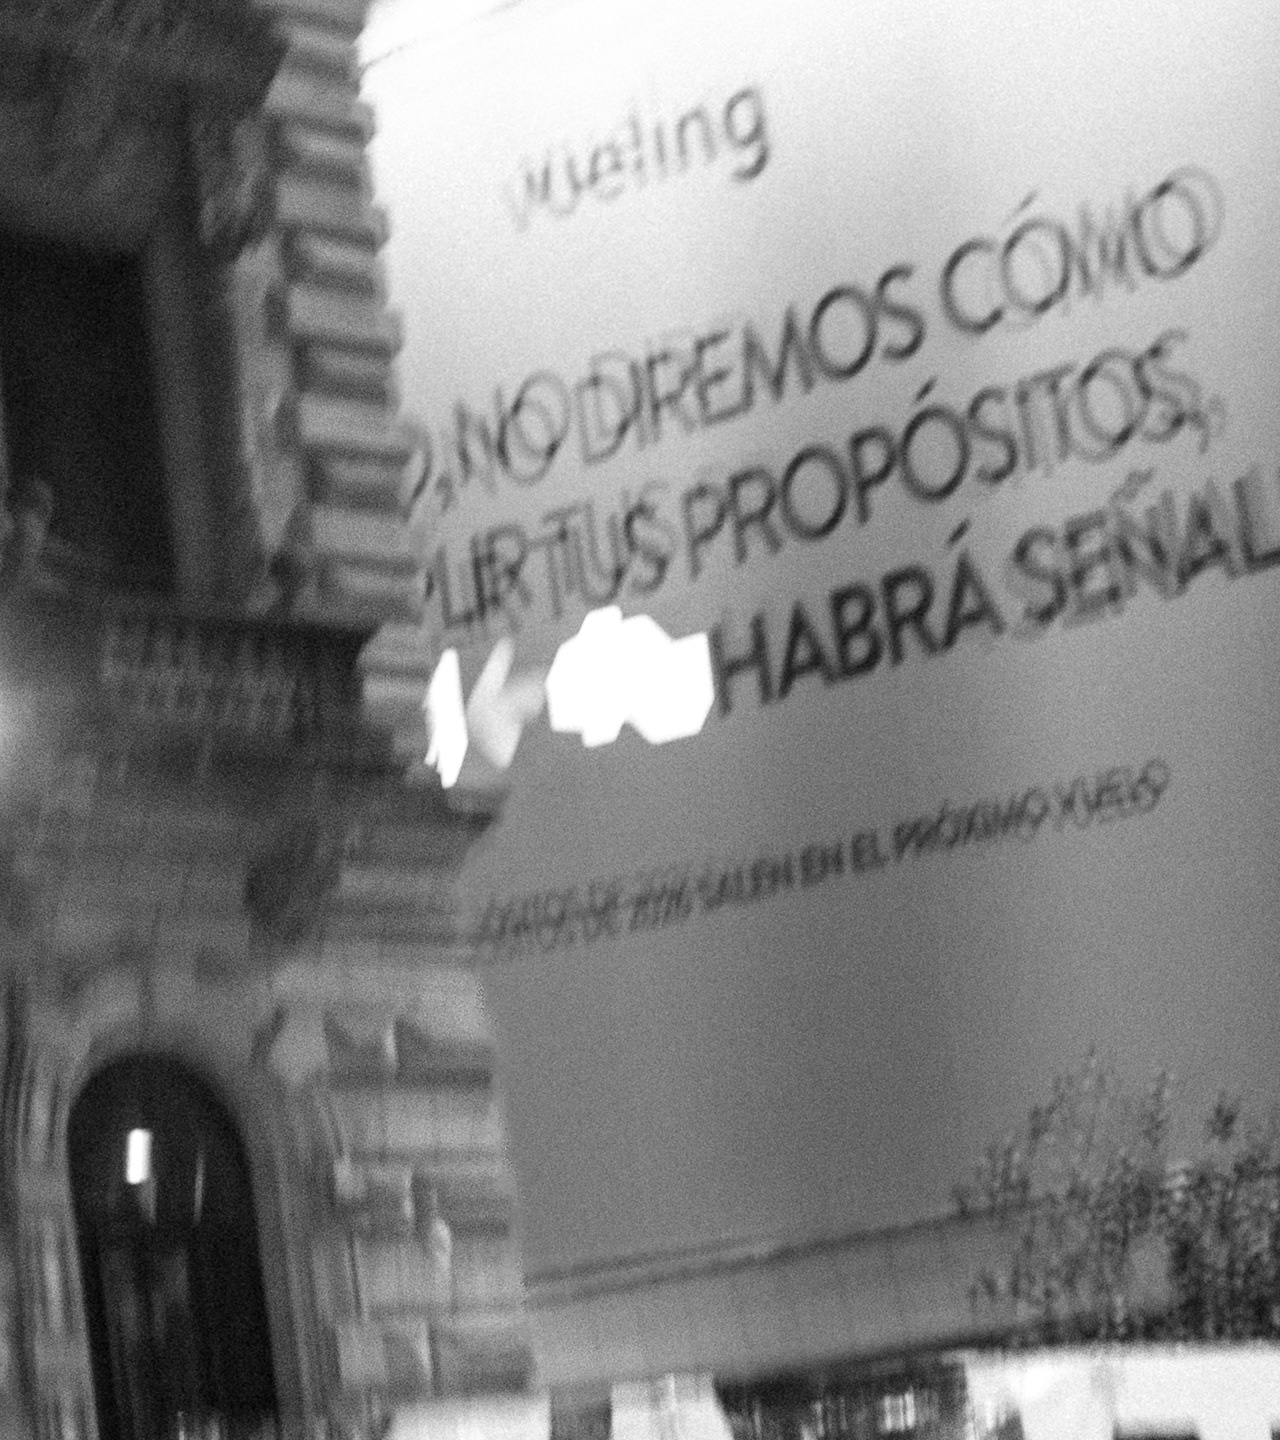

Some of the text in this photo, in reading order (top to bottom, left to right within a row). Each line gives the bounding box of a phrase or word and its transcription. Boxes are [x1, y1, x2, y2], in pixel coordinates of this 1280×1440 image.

[456, 368, 571, 494] NO
[576, 262, 925, 466] DIREMOS
[941, 167, 1225, 334] CÓMO
[541, 478, 677, 622] TUS
[713, 518, 1006, 716] HABRÁ
